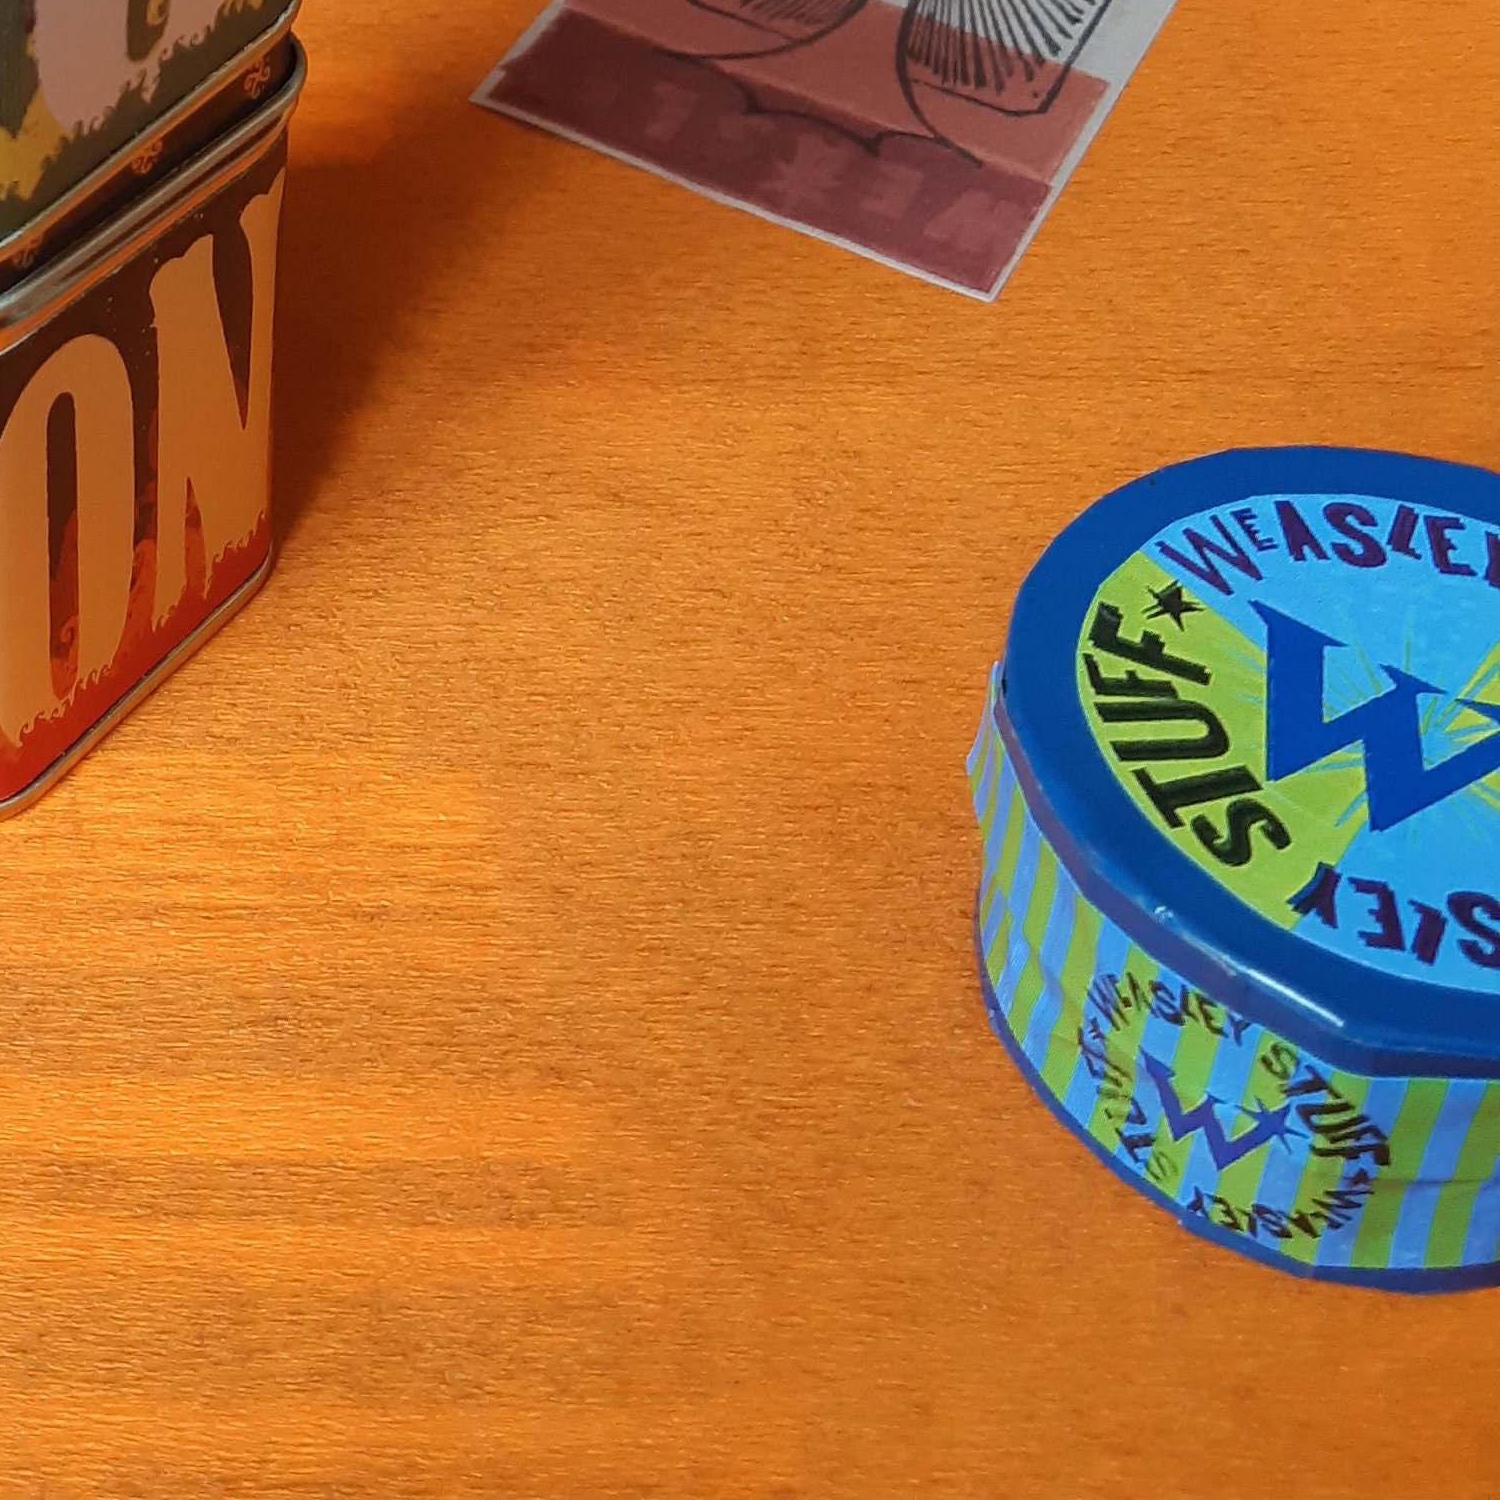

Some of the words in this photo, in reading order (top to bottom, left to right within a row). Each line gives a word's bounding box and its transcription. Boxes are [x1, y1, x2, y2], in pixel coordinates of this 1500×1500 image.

[1081, 600, 1292, 867] STUFF
[1285, 861, 1500, 970] SLEY
[1087, 972, 1254, 1046] WEASLEY
[1260, 1041, 1390, 1166] STUFF
[1186, 1186, 1374, 1239] WEASLEY
